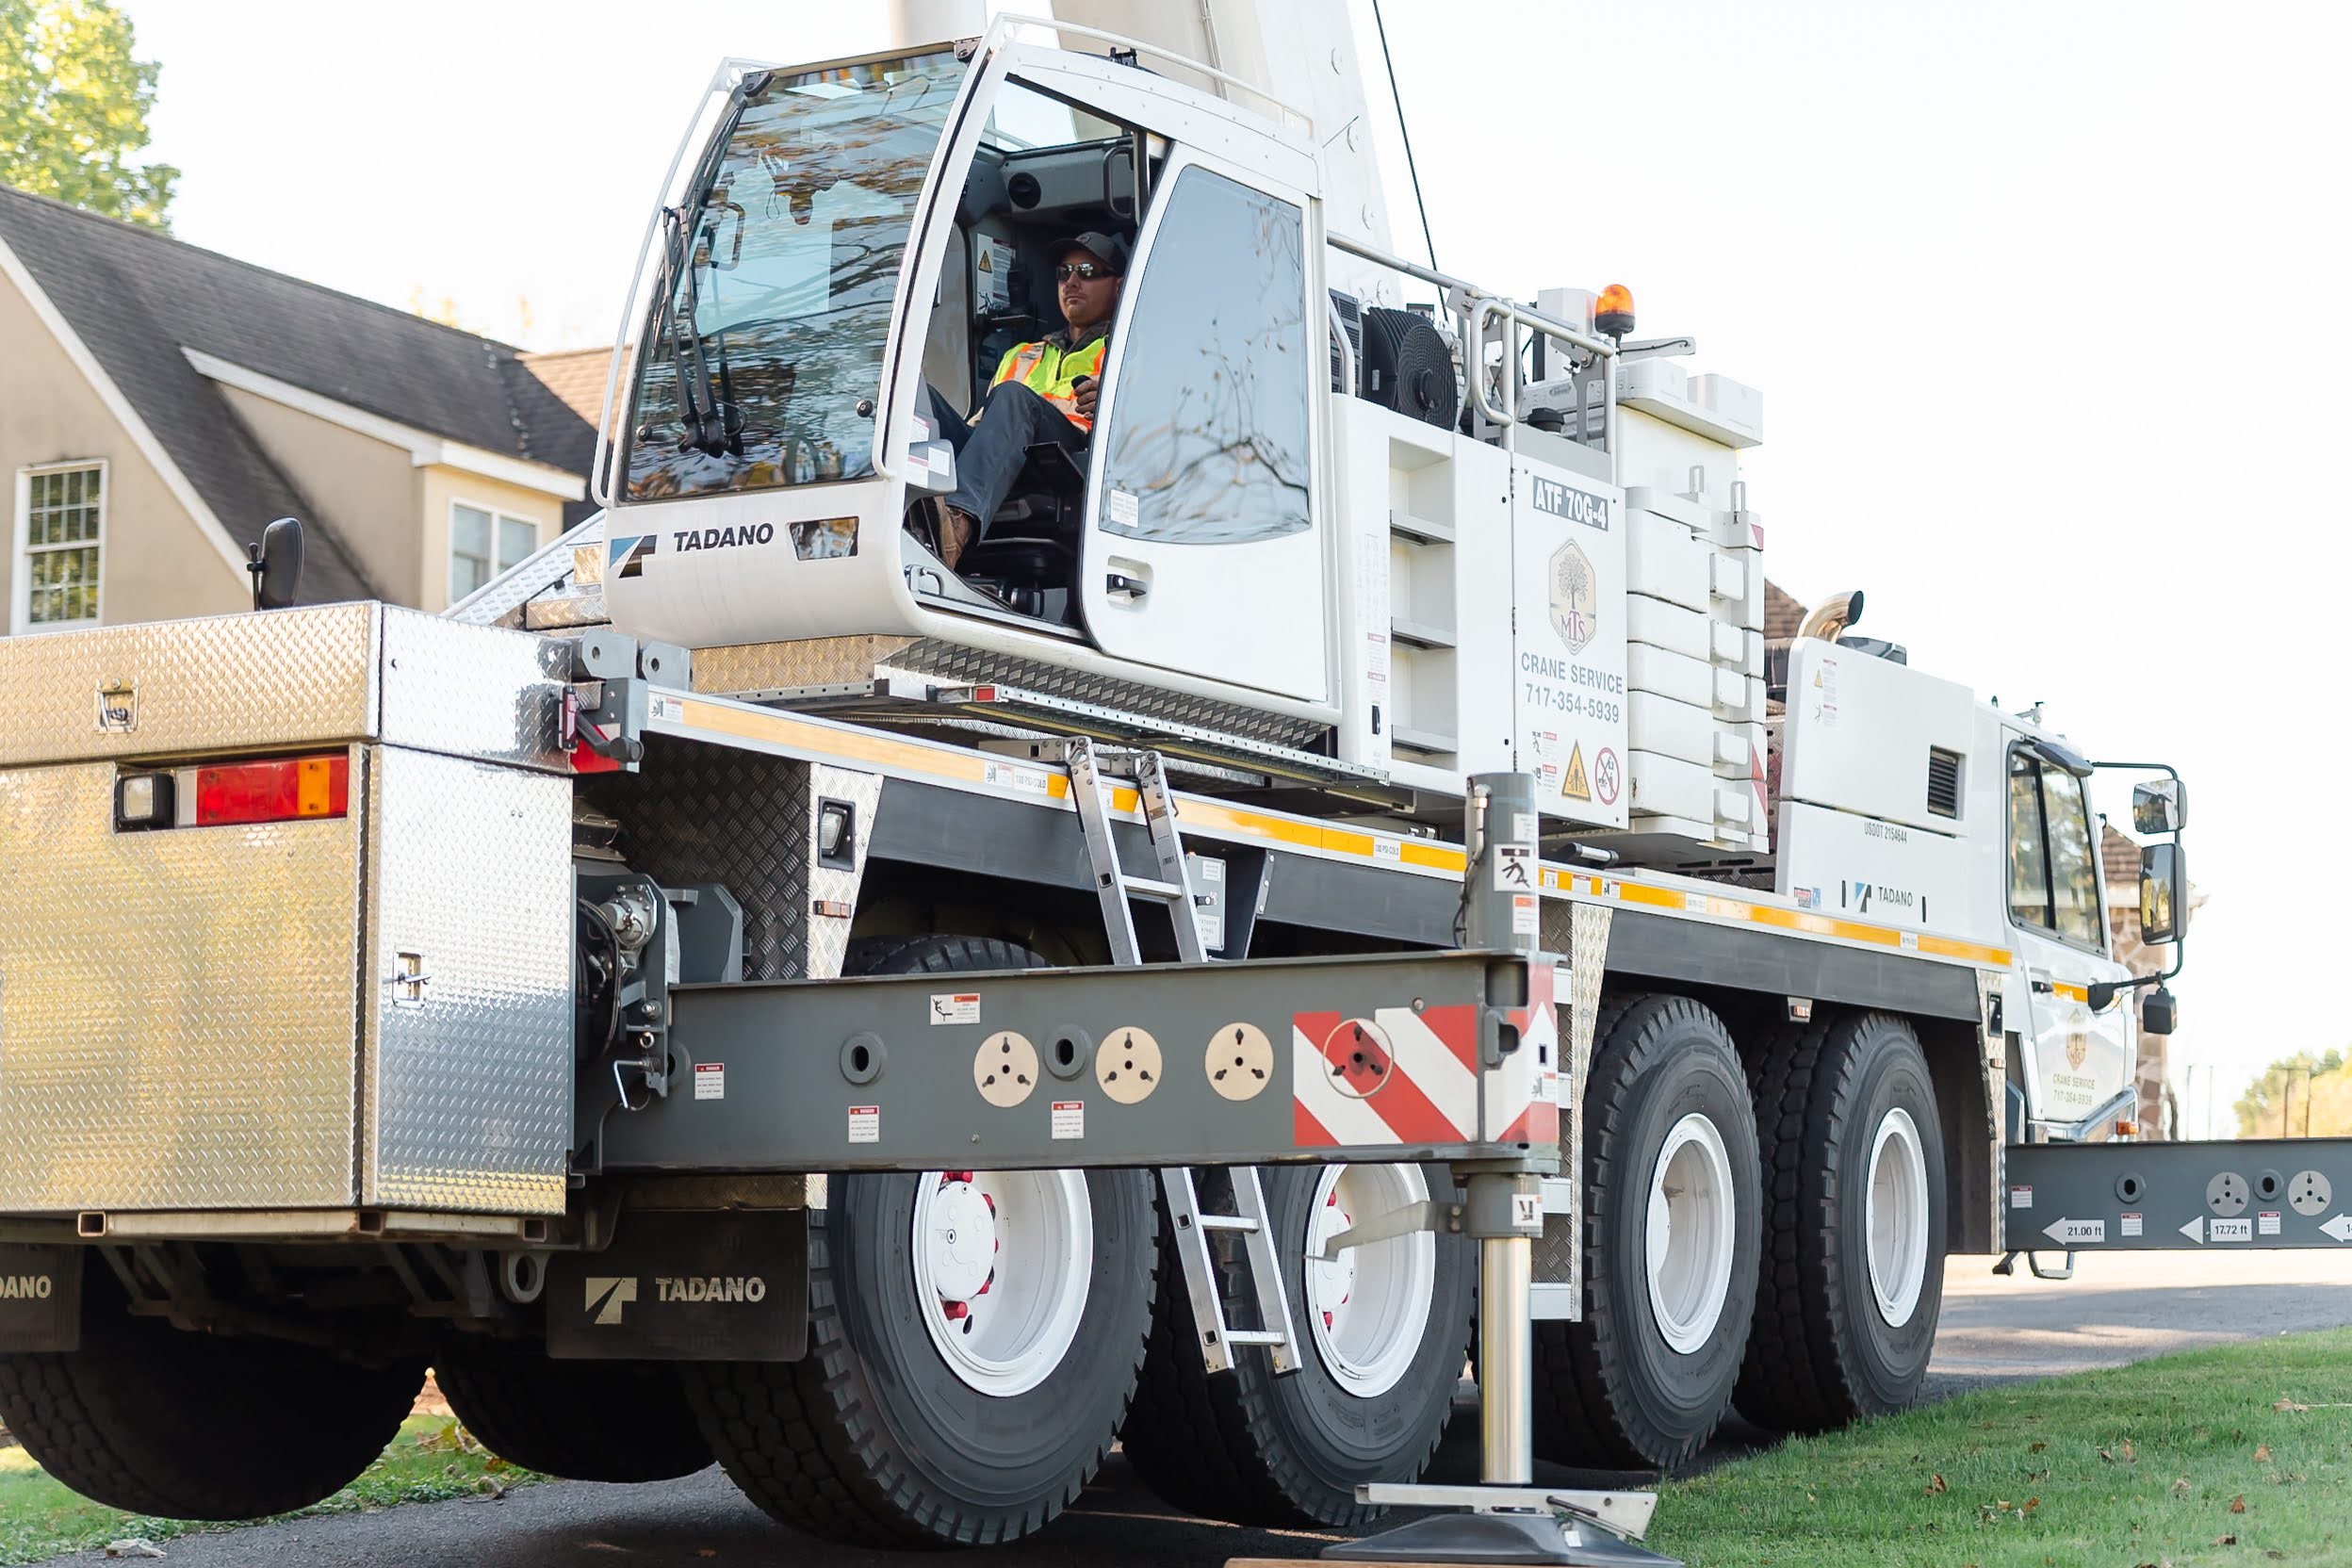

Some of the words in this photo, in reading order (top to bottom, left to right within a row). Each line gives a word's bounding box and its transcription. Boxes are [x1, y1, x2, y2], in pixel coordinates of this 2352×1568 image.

[1534, 480, 1562, 513] ATF
[1565, 489, 1607, 529] 70G-4
[674, 523, 774, 551] TADANO
[1560, 610, 1586, 644] MTS
[1521, 652, 1565, 680] CRANE
[1570, 664, 1624, 694] SERVICE
[1526, 683, 1620, 724] 717-354-5939
[1864, 822, 1884, 838] USDOT
[1878, 886, 1913, 906] TADANO
[2052, 1073, 2071, 1086] CRANE
[2072, 1074, 2096, 1089] SERVICE
[2067, 1226, 2092, 1236] 21.00
[2095, 1226, 2102, 1236] ft
[2214, 1224, 2238, 1234] 17.72
[2240, 1224, 2247, 1234] ft
[656, 1277, 765, 1302] TADANO
